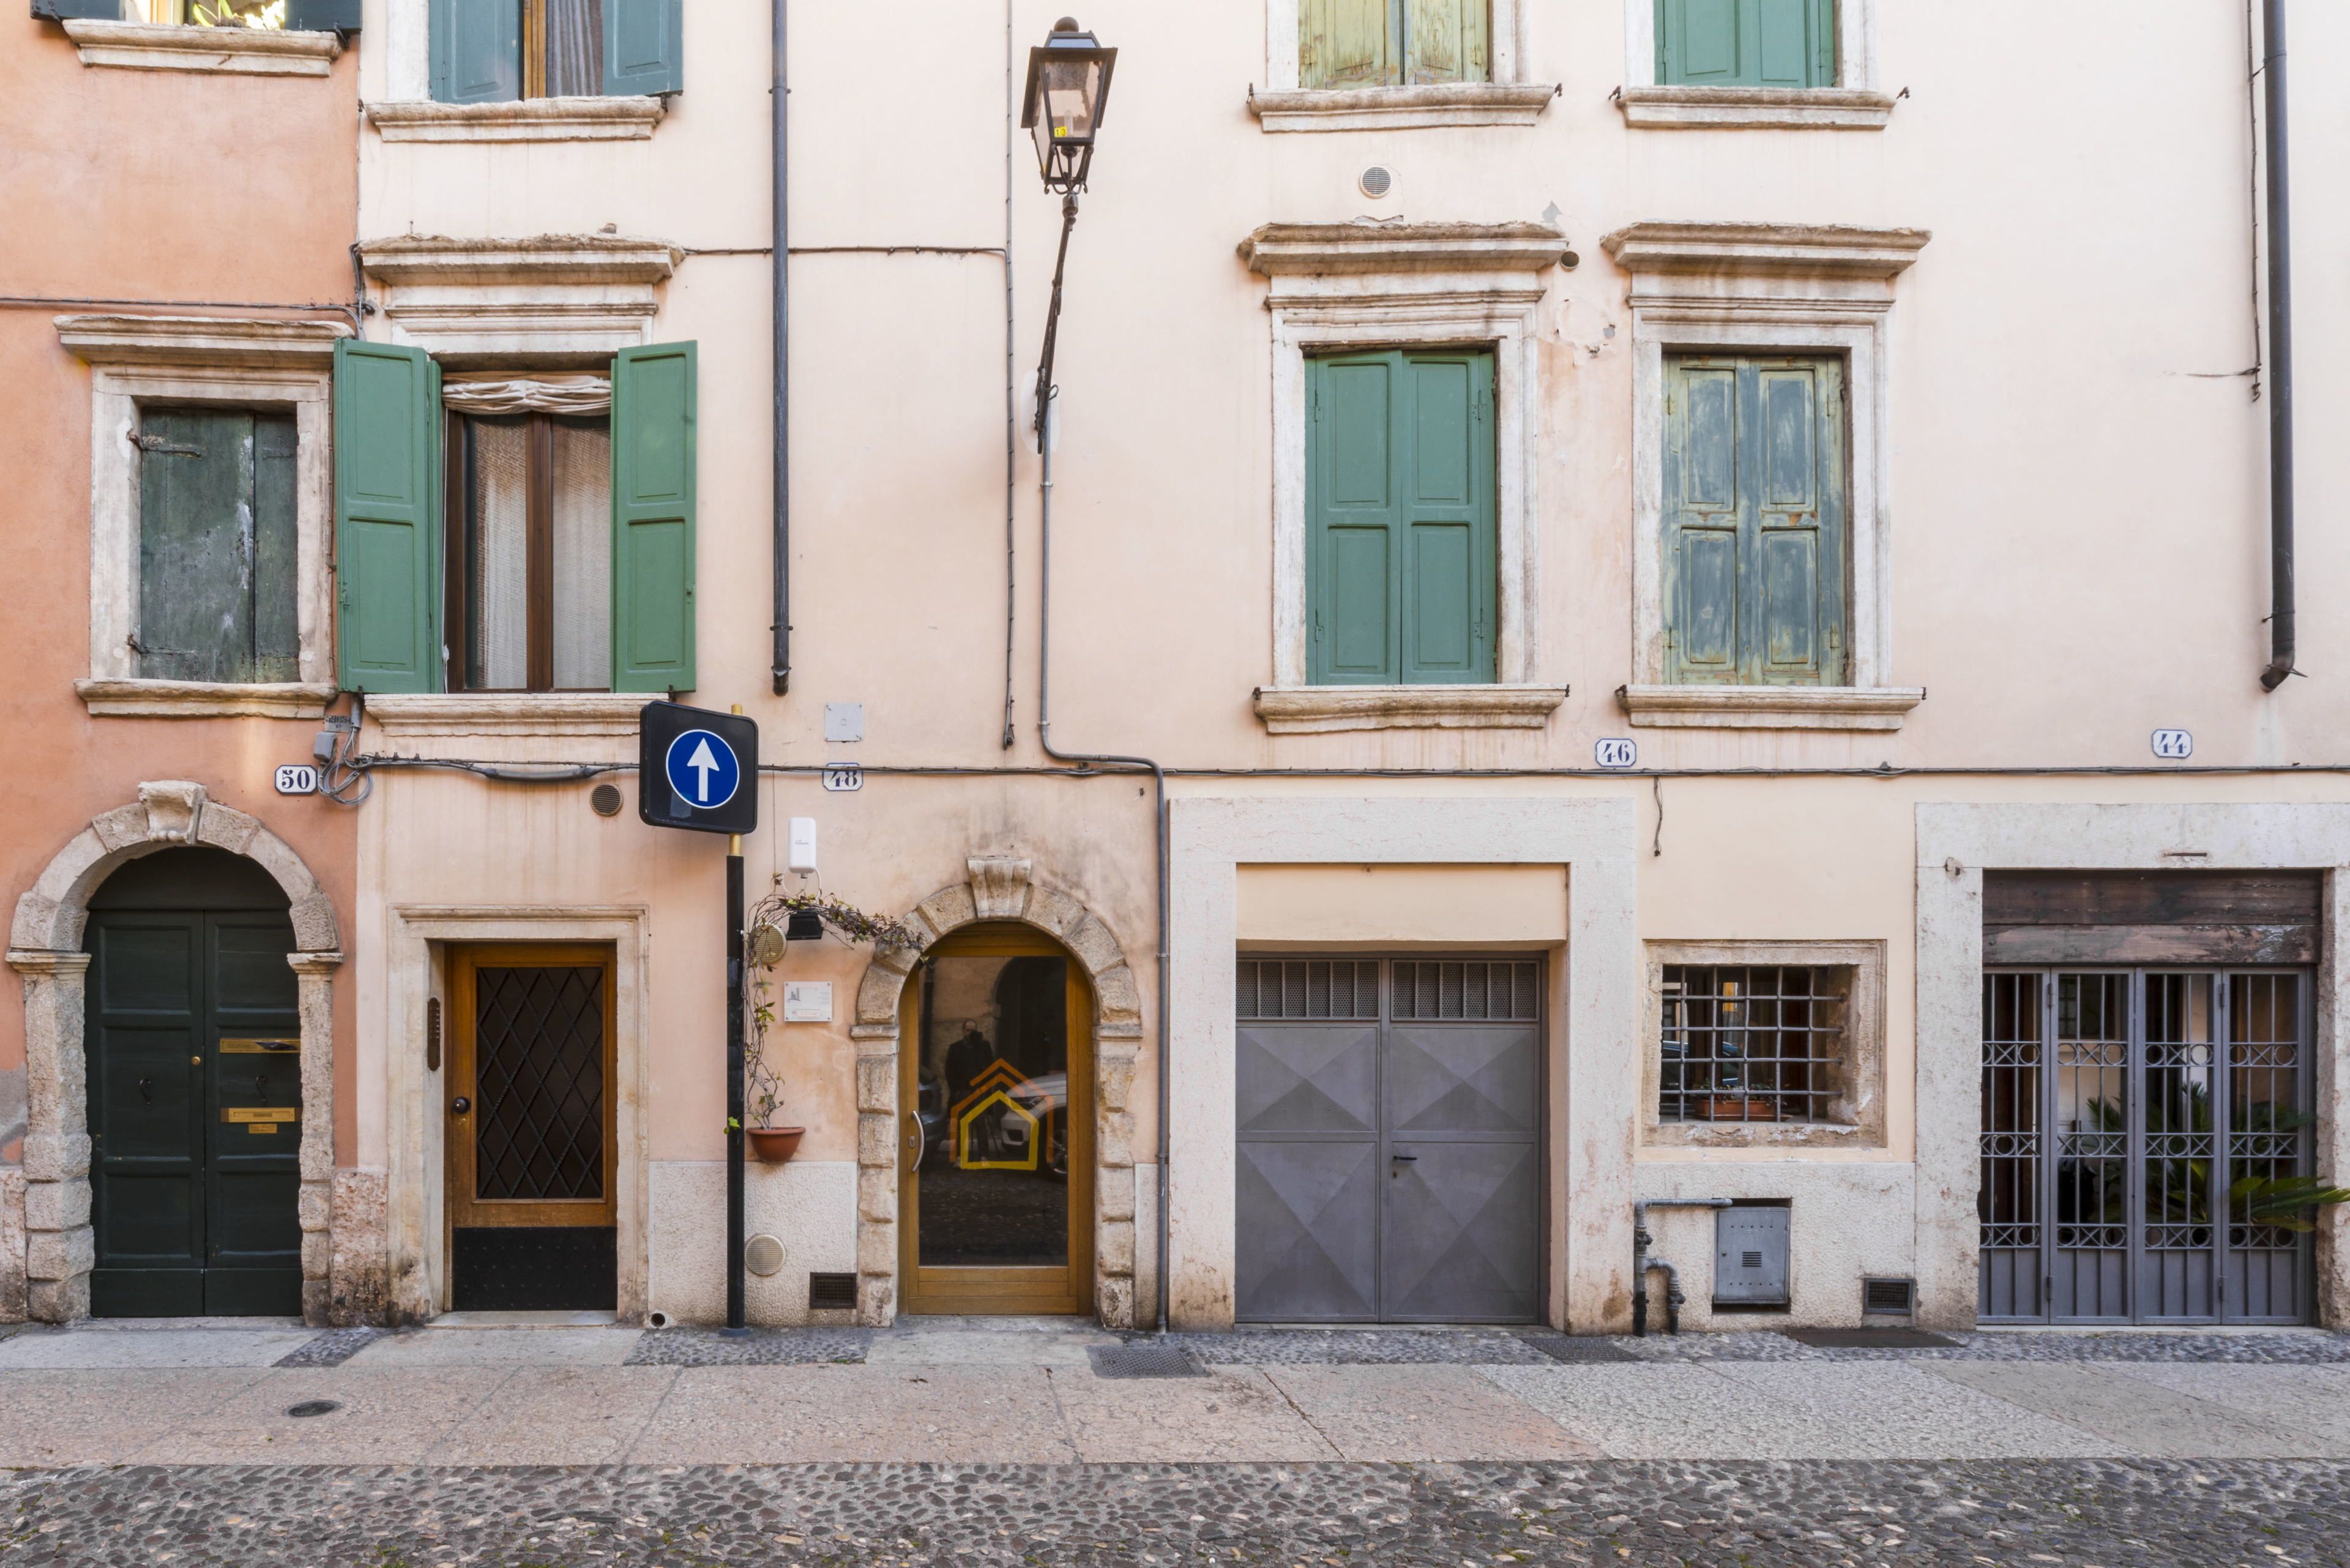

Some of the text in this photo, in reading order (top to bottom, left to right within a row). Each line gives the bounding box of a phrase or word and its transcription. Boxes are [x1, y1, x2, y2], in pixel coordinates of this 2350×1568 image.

[1056, 128, 1066, 136] 13
[1601, 743, 1630, 763] 46
[2157, 734, 2187, 753] 44
[282, 769, 310, 789] 50
[829, 769, 857, 787] 48
